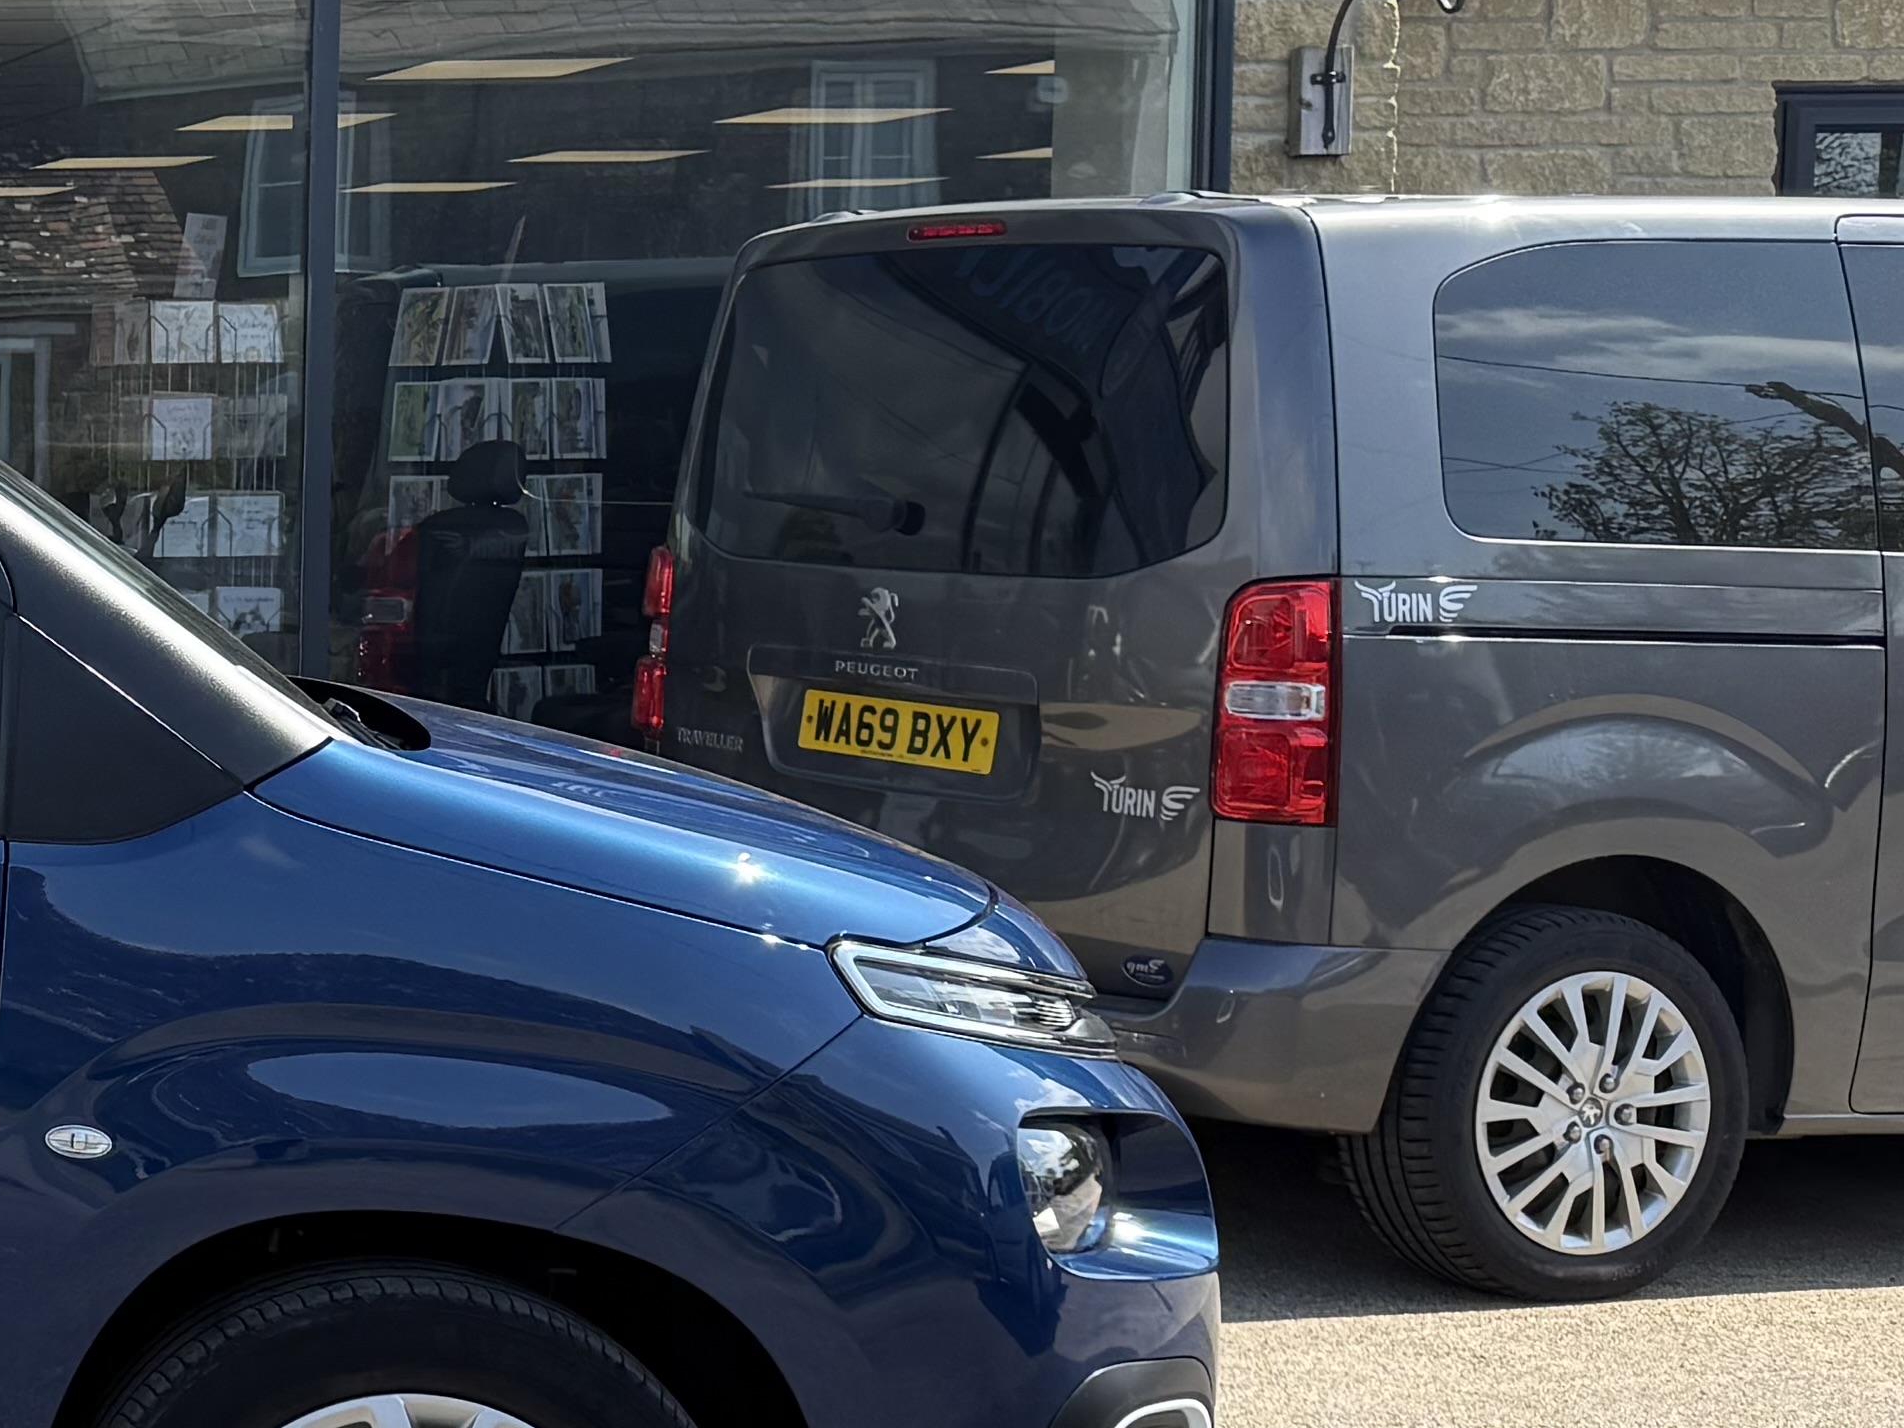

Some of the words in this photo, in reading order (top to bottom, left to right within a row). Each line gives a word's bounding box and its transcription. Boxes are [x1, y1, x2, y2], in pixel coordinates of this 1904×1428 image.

[1354, 580, 1434, 623] TURIN
[834, 659, 920, 680] PEUGEOT
[676, 726, 744, 753] TRAVELLER
[814, 698, 900, 751] WA69
[907, 710, 982, 763] BXY
[1090, 771, 1156, 818] TURIN
